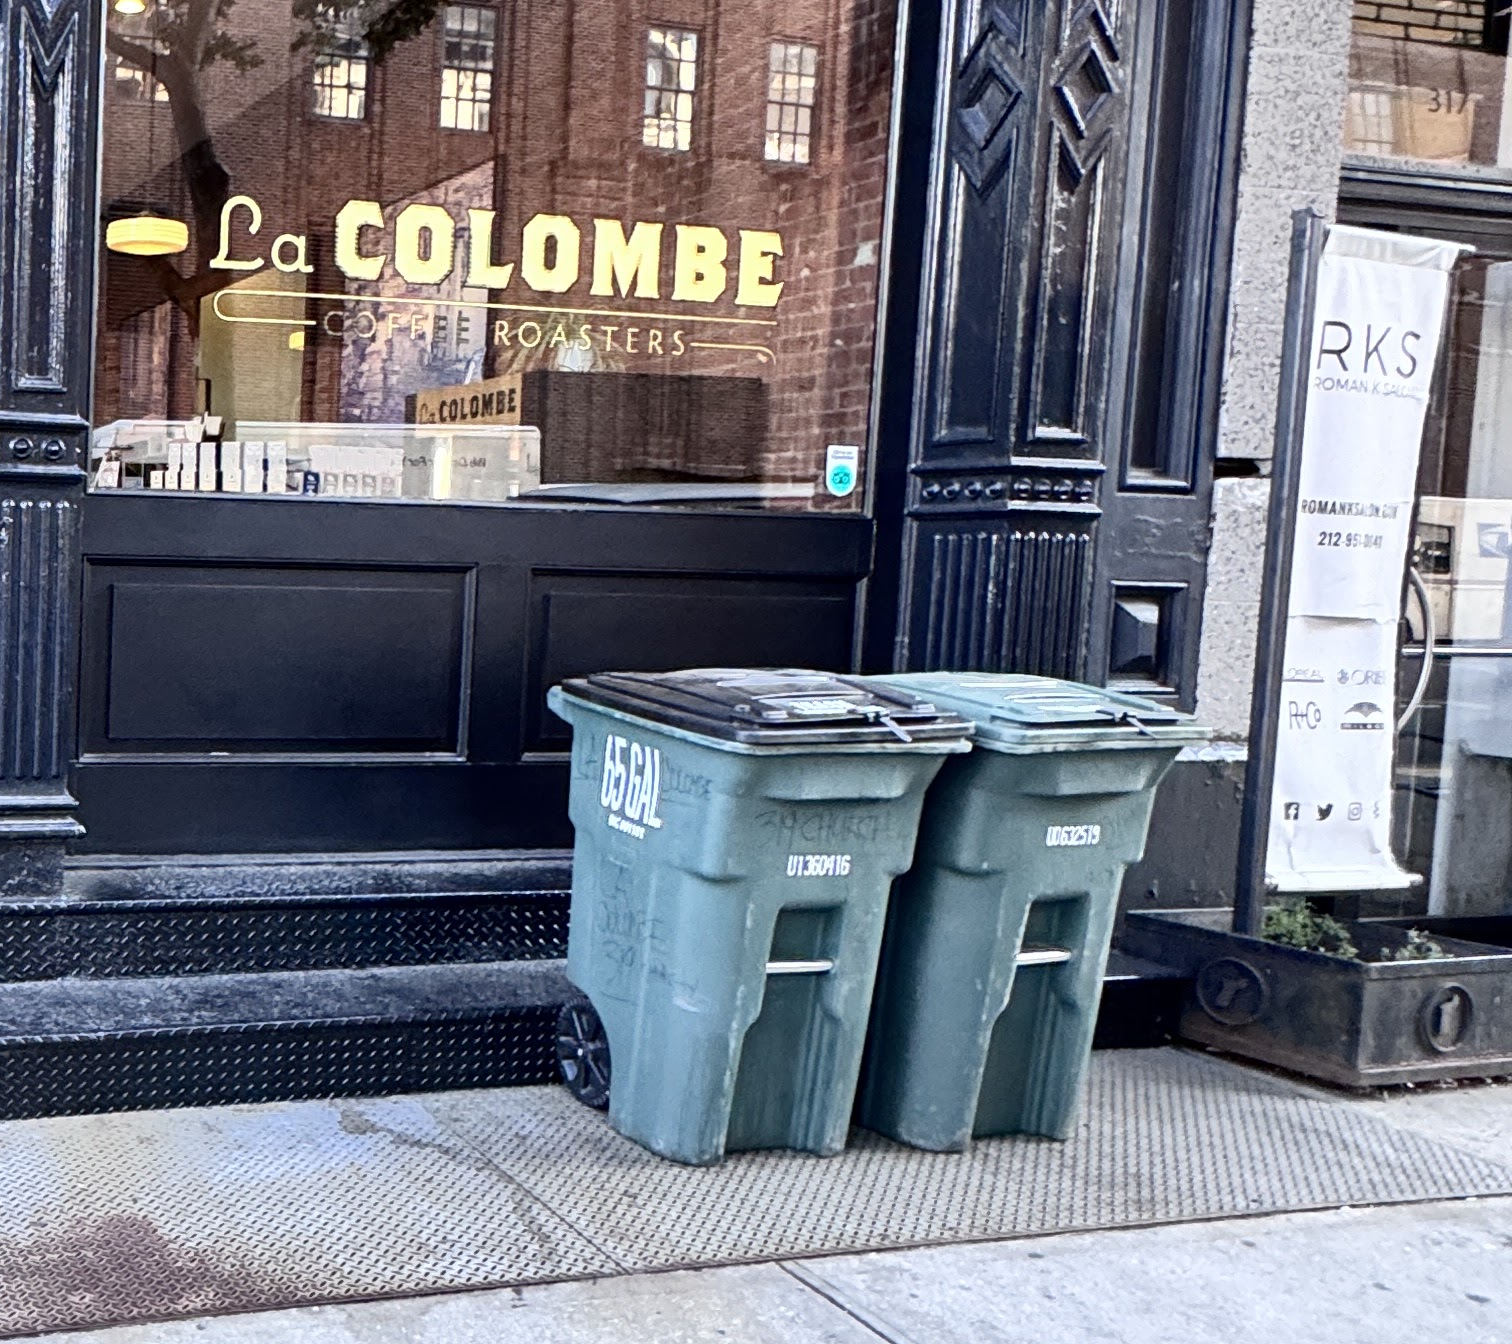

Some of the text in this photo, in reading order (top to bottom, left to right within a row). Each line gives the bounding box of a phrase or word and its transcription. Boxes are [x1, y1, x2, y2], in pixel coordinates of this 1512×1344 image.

[1427, 86, 1469, 115] 317
[209, 194, 785, 308] La COLOMBE
[323, 310, 686, 356] COFFEE ROASTERS
[1316, 320, 1421, 379] RKS
[439, 387, 517, 423] COLOMBE
[1313, 375, 1369, 394] ROMAN
[1371, 378, 1383, 396] K
[1288, 700, 1322, 730] R+Co
[600, 734, 628, 812] 65
[624, 741, 664, 829] GAL
